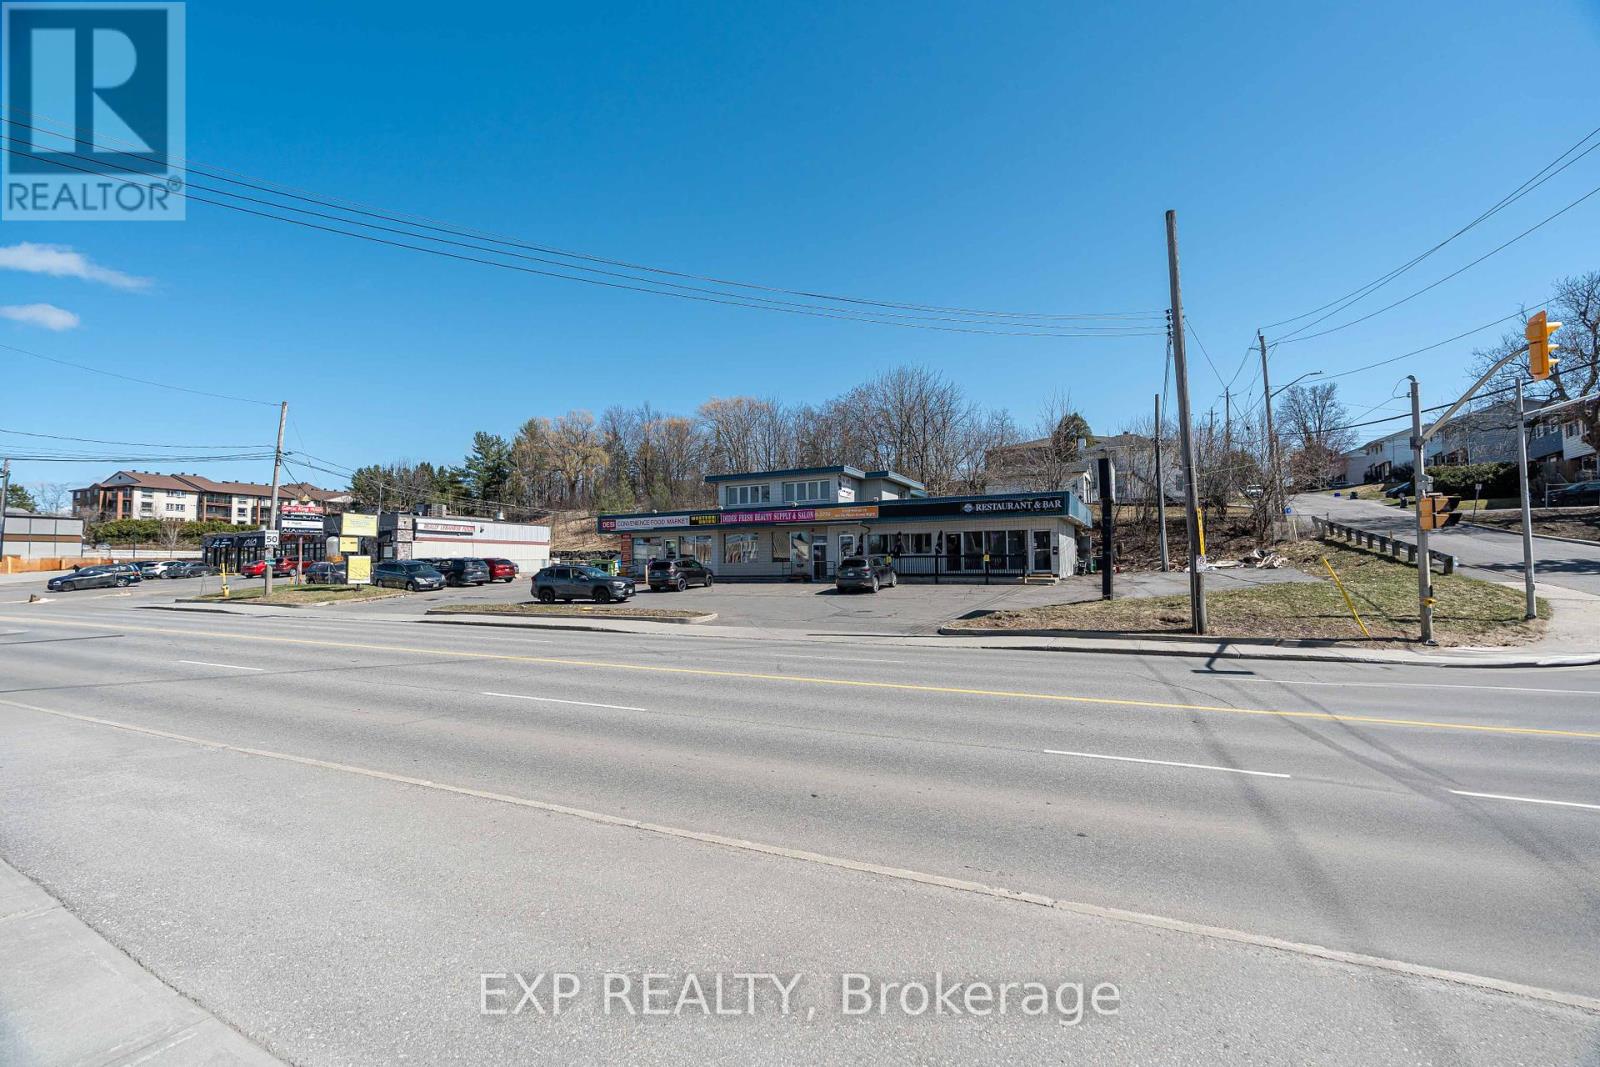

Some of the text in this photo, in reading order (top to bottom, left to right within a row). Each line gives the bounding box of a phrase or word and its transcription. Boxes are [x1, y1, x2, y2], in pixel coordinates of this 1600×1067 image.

[975, 499, 1062, 512] RESTAURANT & BAR
[755, 512, 772, 521] BEAUTY
[773, 511, 791, 520] SUPPLY
[798, 510, 814, 519] SALON
[617, 518, 650, 527] CONVENIENCE
[650, 518, 665, 526] FOOD
[667, 517, 689, 525] MARKET
[266, 535, 278, 543] 50
